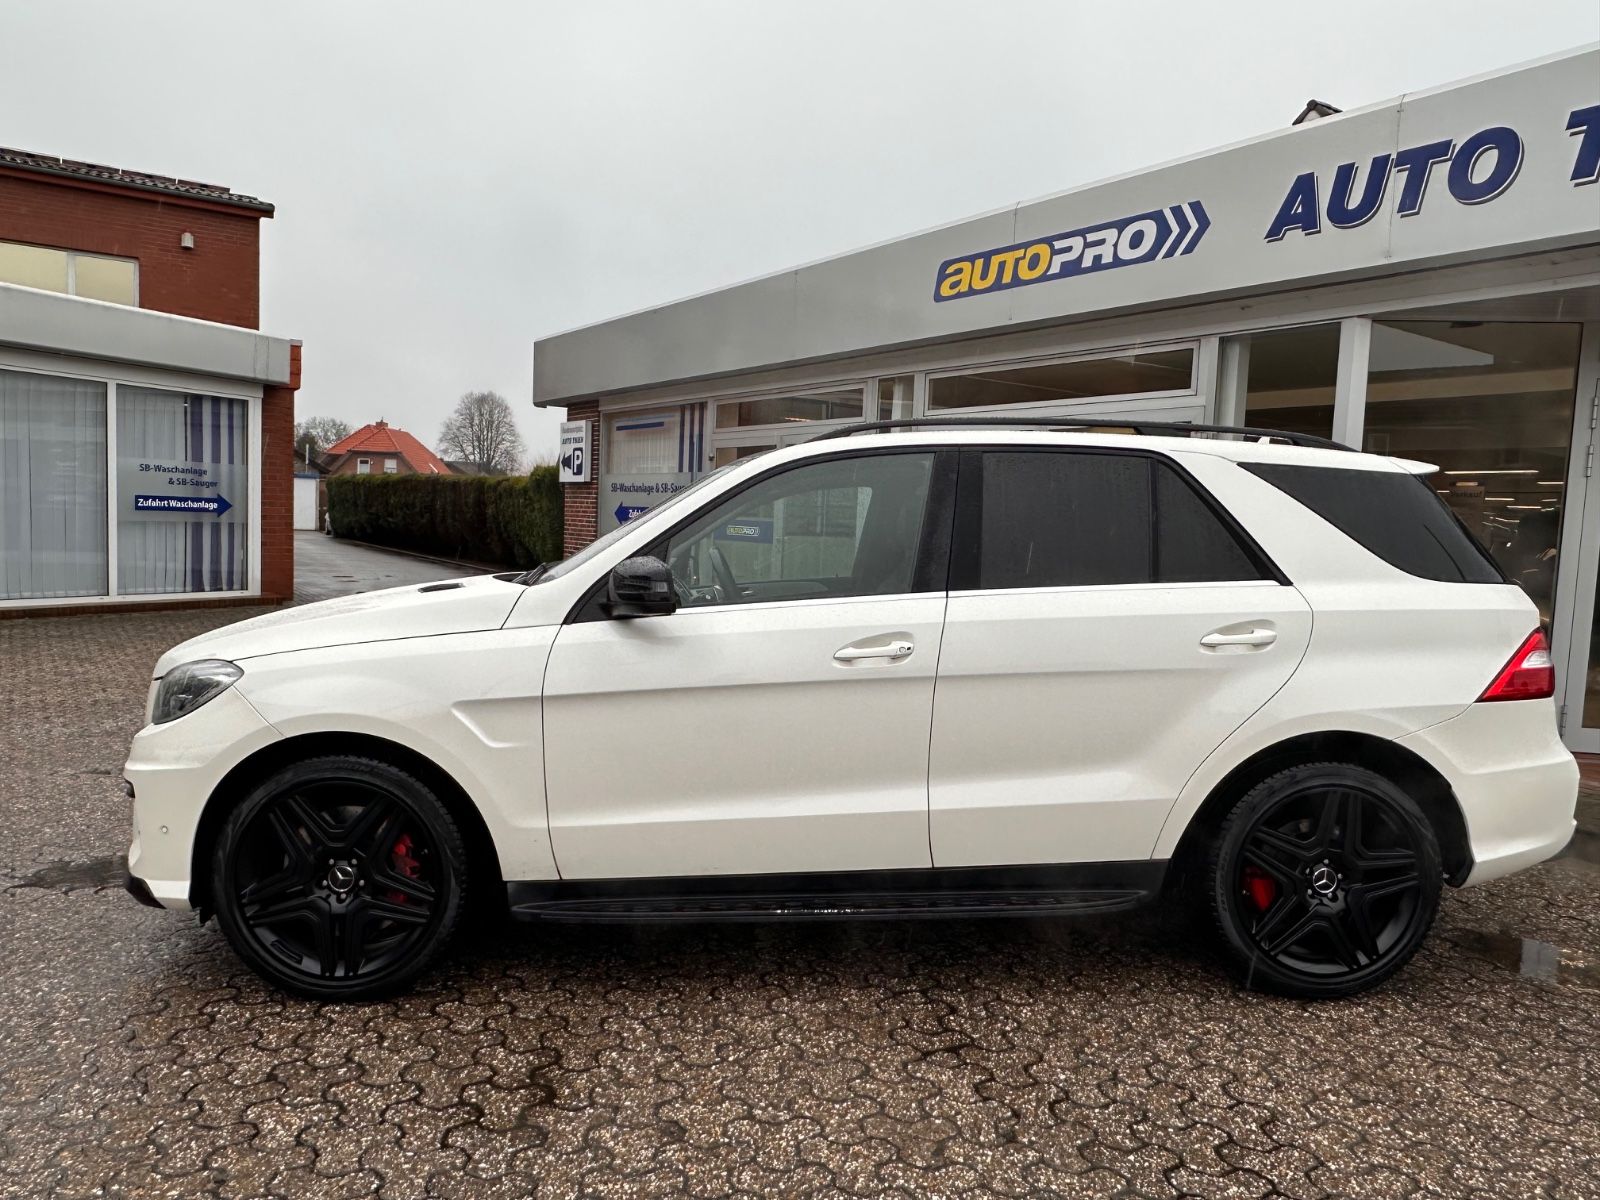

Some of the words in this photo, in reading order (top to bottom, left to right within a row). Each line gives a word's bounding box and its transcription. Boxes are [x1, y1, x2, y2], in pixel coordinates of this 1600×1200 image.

[1264, 126, 1524, 243] AUTO
[574, 450, 582, 473] P
[139, 463, 208, 477] SB-Waschanlage
[176, 478, 218, 488] SB-Sauger
[611, 482, 654, 495] SB-Waschanlage
[655, 483, 660, 493] &
[137, 498, 168, 507] Zufahrt
[169, 499, 218, 509] Waschanlage
